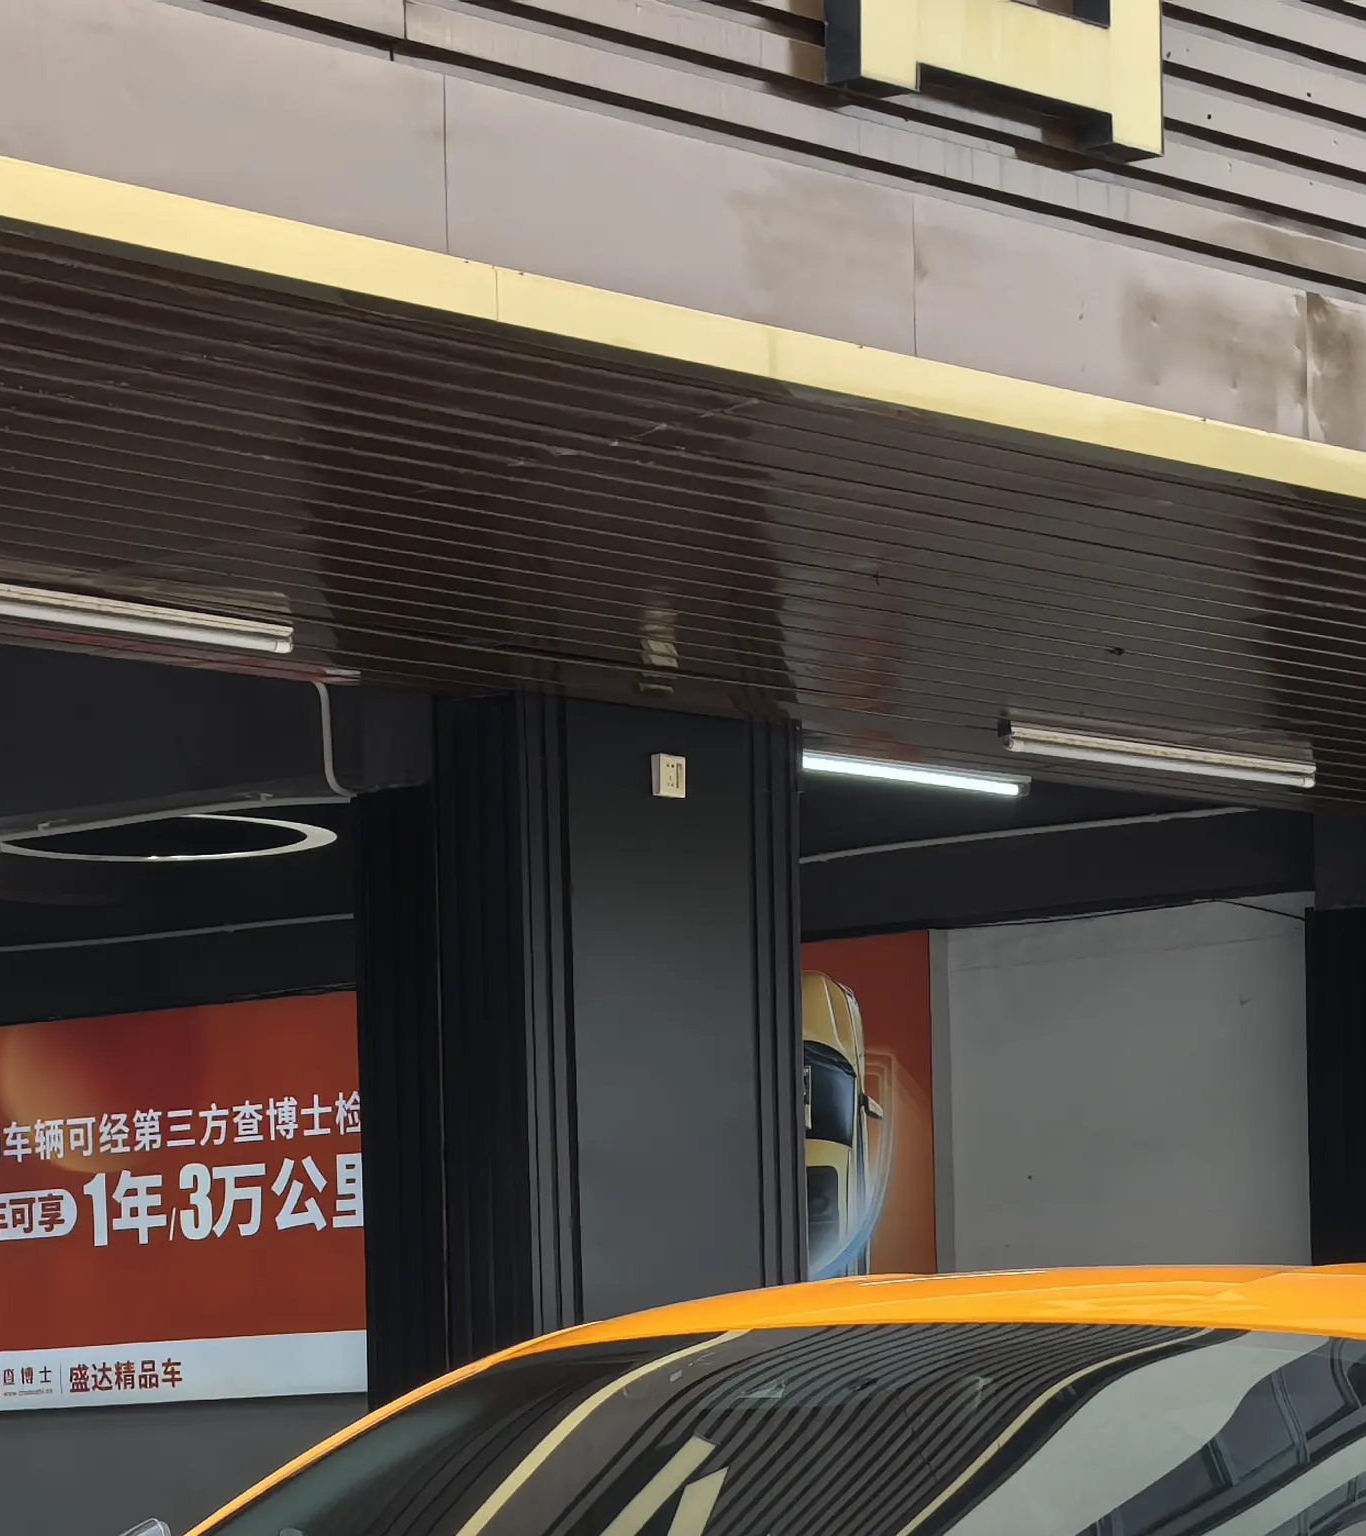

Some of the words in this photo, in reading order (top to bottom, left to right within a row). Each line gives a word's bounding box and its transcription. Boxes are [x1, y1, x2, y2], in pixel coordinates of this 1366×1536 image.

[69, 1358, 183, 1393] 盛达精品车
